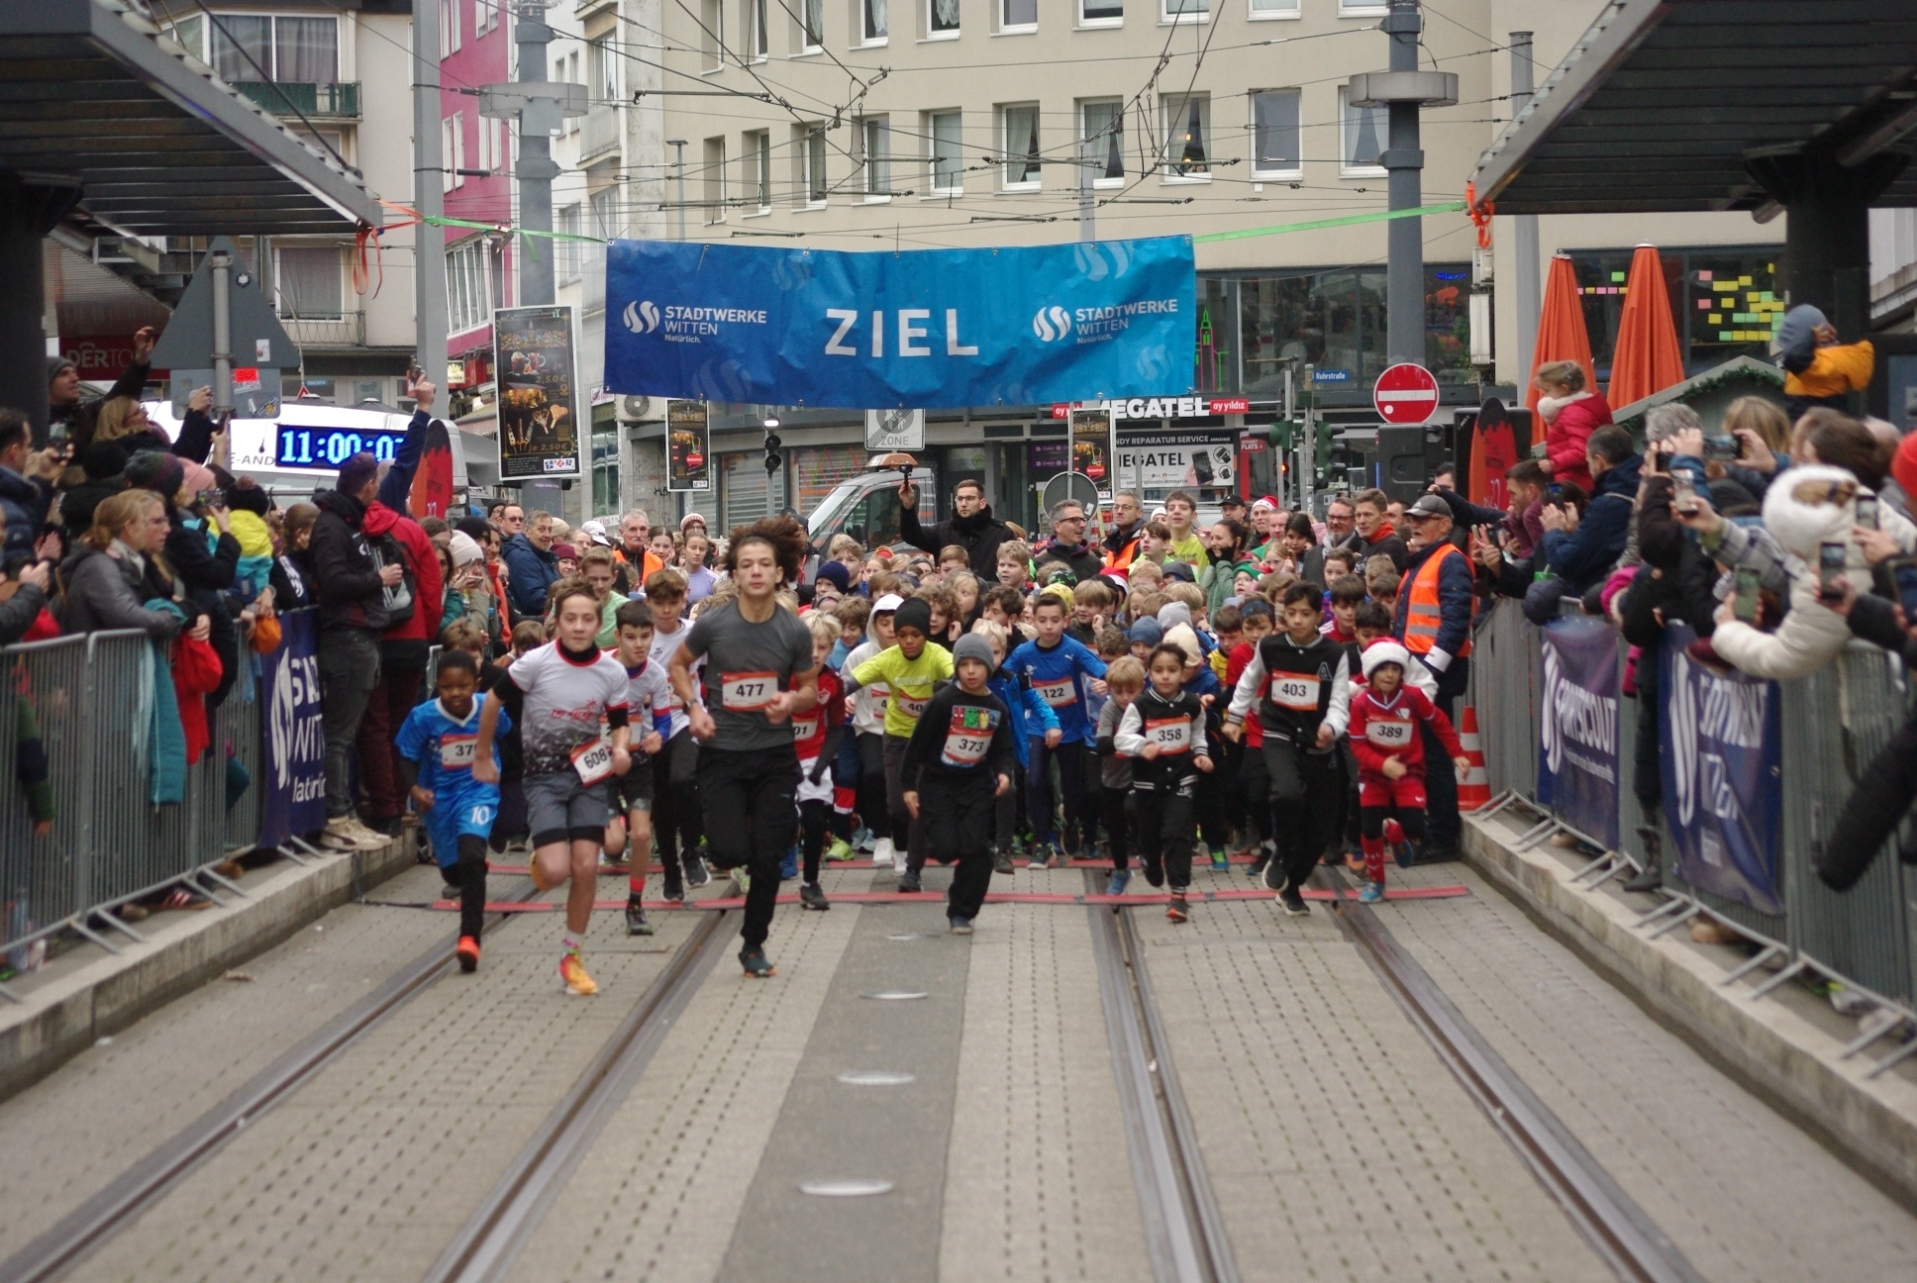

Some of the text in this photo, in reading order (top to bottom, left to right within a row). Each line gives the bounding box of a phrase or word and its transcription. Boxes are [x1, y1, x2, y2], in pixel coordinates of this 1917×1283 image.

[665, 306, 767, 323] STADTWERKE
[1076, 299, 1178, 322] STADTWERKE
[665, 321, 718, 335] WITTEN
[825, 308, 979, 358] ZIEL
[1077, 318, 1129, 335] WITTEN
[665, 334, 701, 343] Natürlich.
[66, 349, 133, 368] DERTO
[1315, 372, 1346, 380] Ruhrstraße
[1213, 404, 1223, 412] ay
[881, 436, 909, 446] ZONE
[1116, 437, 1130, 445] NDY
[1132, 436, 1176, 445] REPARATUR
[1177, 435, 1209, 443] SERVICE
[280, 431, 405, 464] 11:00:0
[1118, 452, 1186, 467] EGATEL
[736, 684, 765, 697] 477
[1043, 687, 1065, 699] 122
[1282, 683, 1307, 697] 403
[908, 703, 923, 713] 40
[794, 725, 808, 736] 01
[1158, 728, 1182, 742] 358
[1377, 725, 1403, 738] 389
[455, 744, 478, 757] 37
[958, 738, 984, 753] 373
[583, 747, 608, 769] 608
[471, 805, 491, 824] 10
